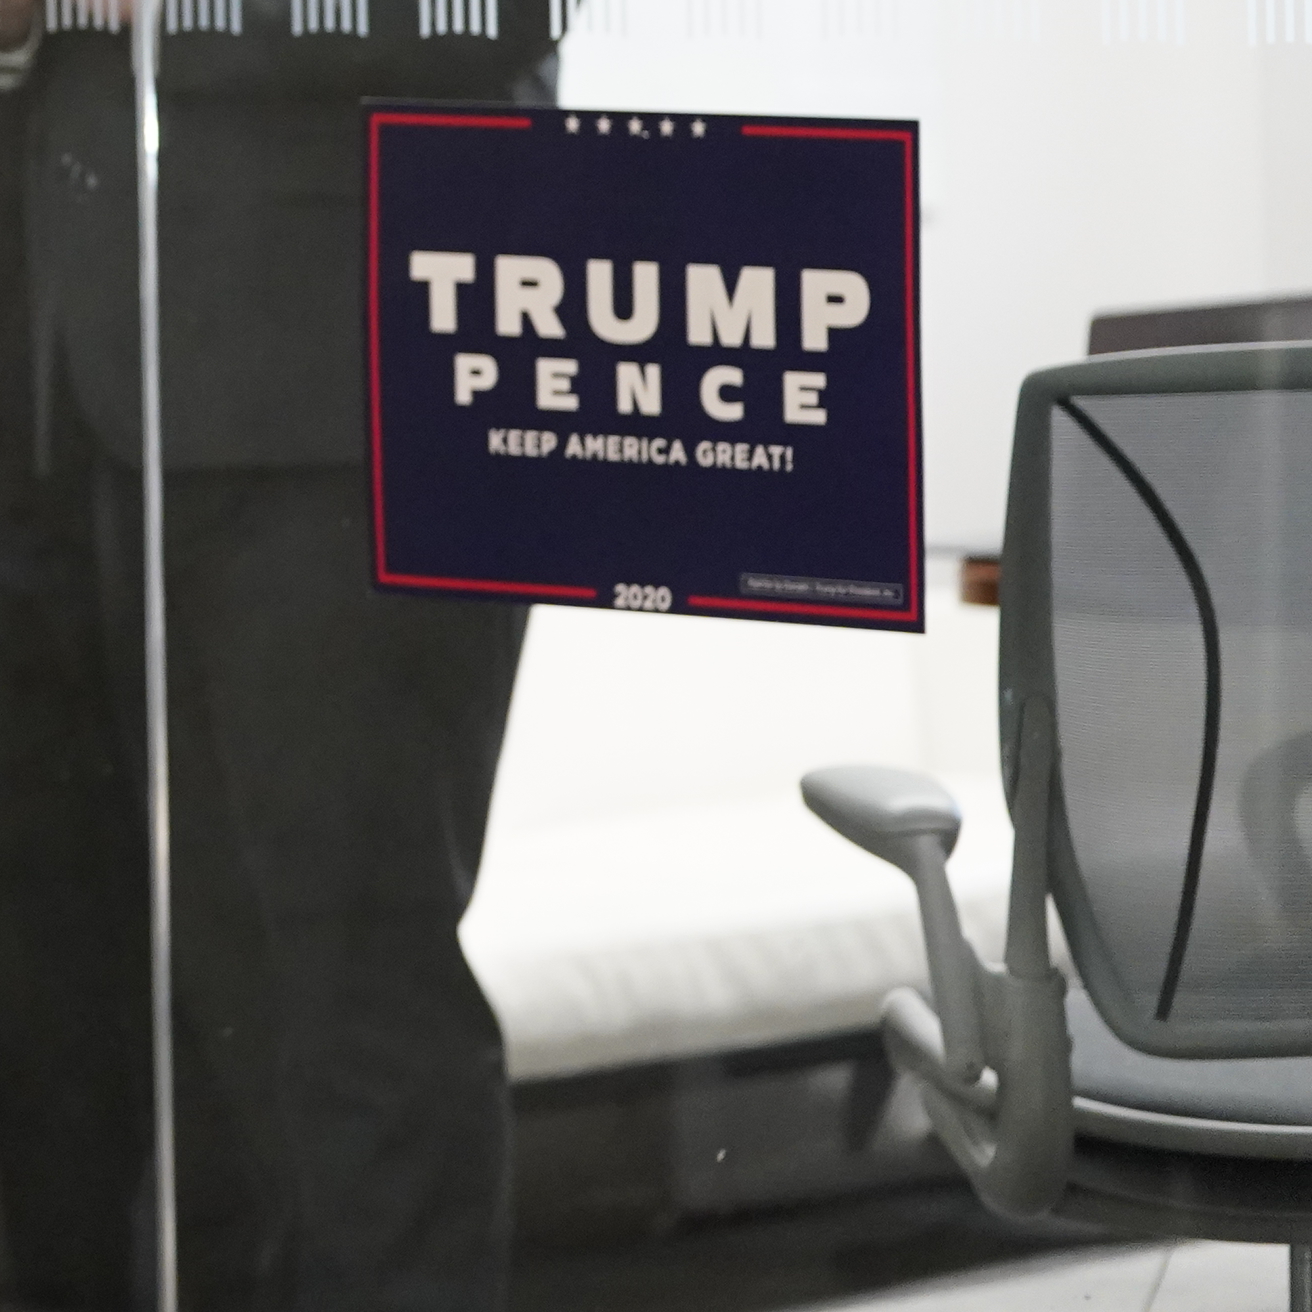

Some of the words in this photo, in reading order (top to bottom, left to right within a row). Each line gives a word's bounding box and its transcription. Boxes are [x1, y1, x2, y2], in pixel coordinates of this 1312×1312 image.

[408, 249, 872, 353] TRUMP
[453, 352, 828, 426] PENCE
[488, 427, 558, 458] KEEP
[565, 433, 687, 467] AMERICA
[696, 440, 794, 473] GREAT!
[613, 583, 673, 613] 2020
